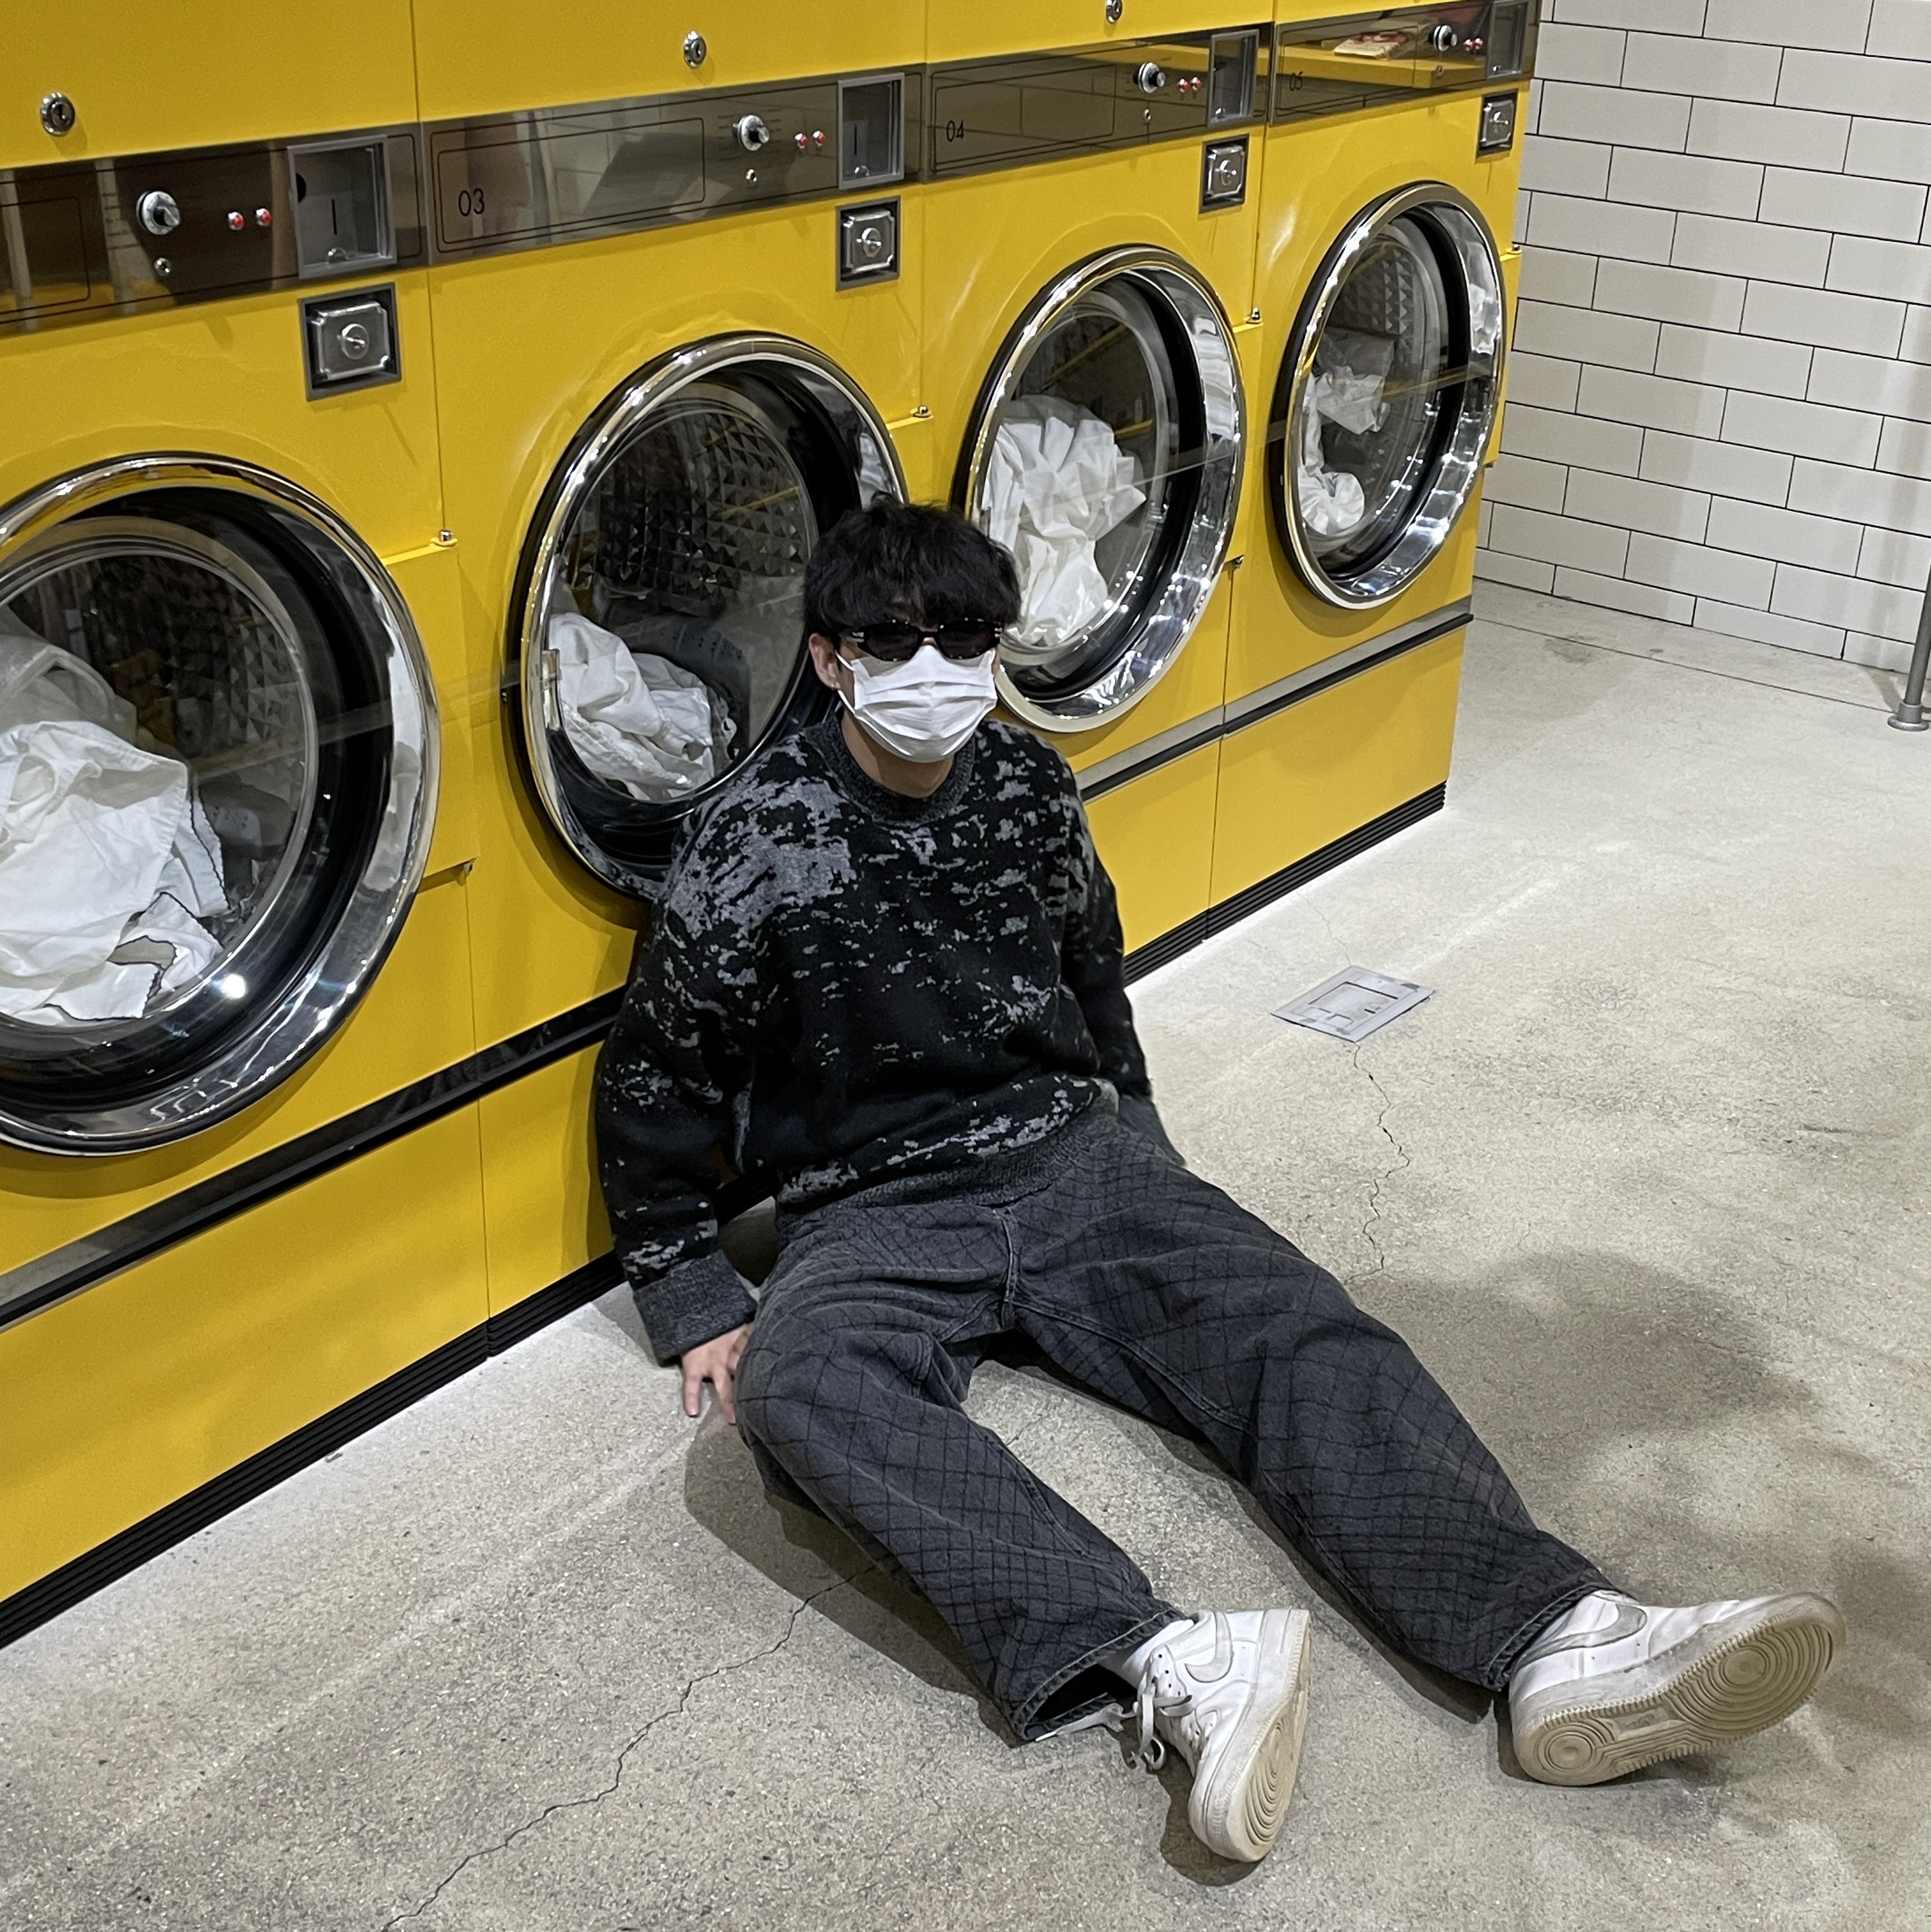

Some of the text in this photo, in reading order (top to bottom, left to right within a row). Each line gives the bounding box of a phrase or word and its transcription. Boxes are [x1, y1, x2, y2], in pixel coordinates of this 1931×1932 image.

[1289, 71, 1303, 92] 05
[946, 119, 964, 142] 04
[458, 188, 485, 217] 03
